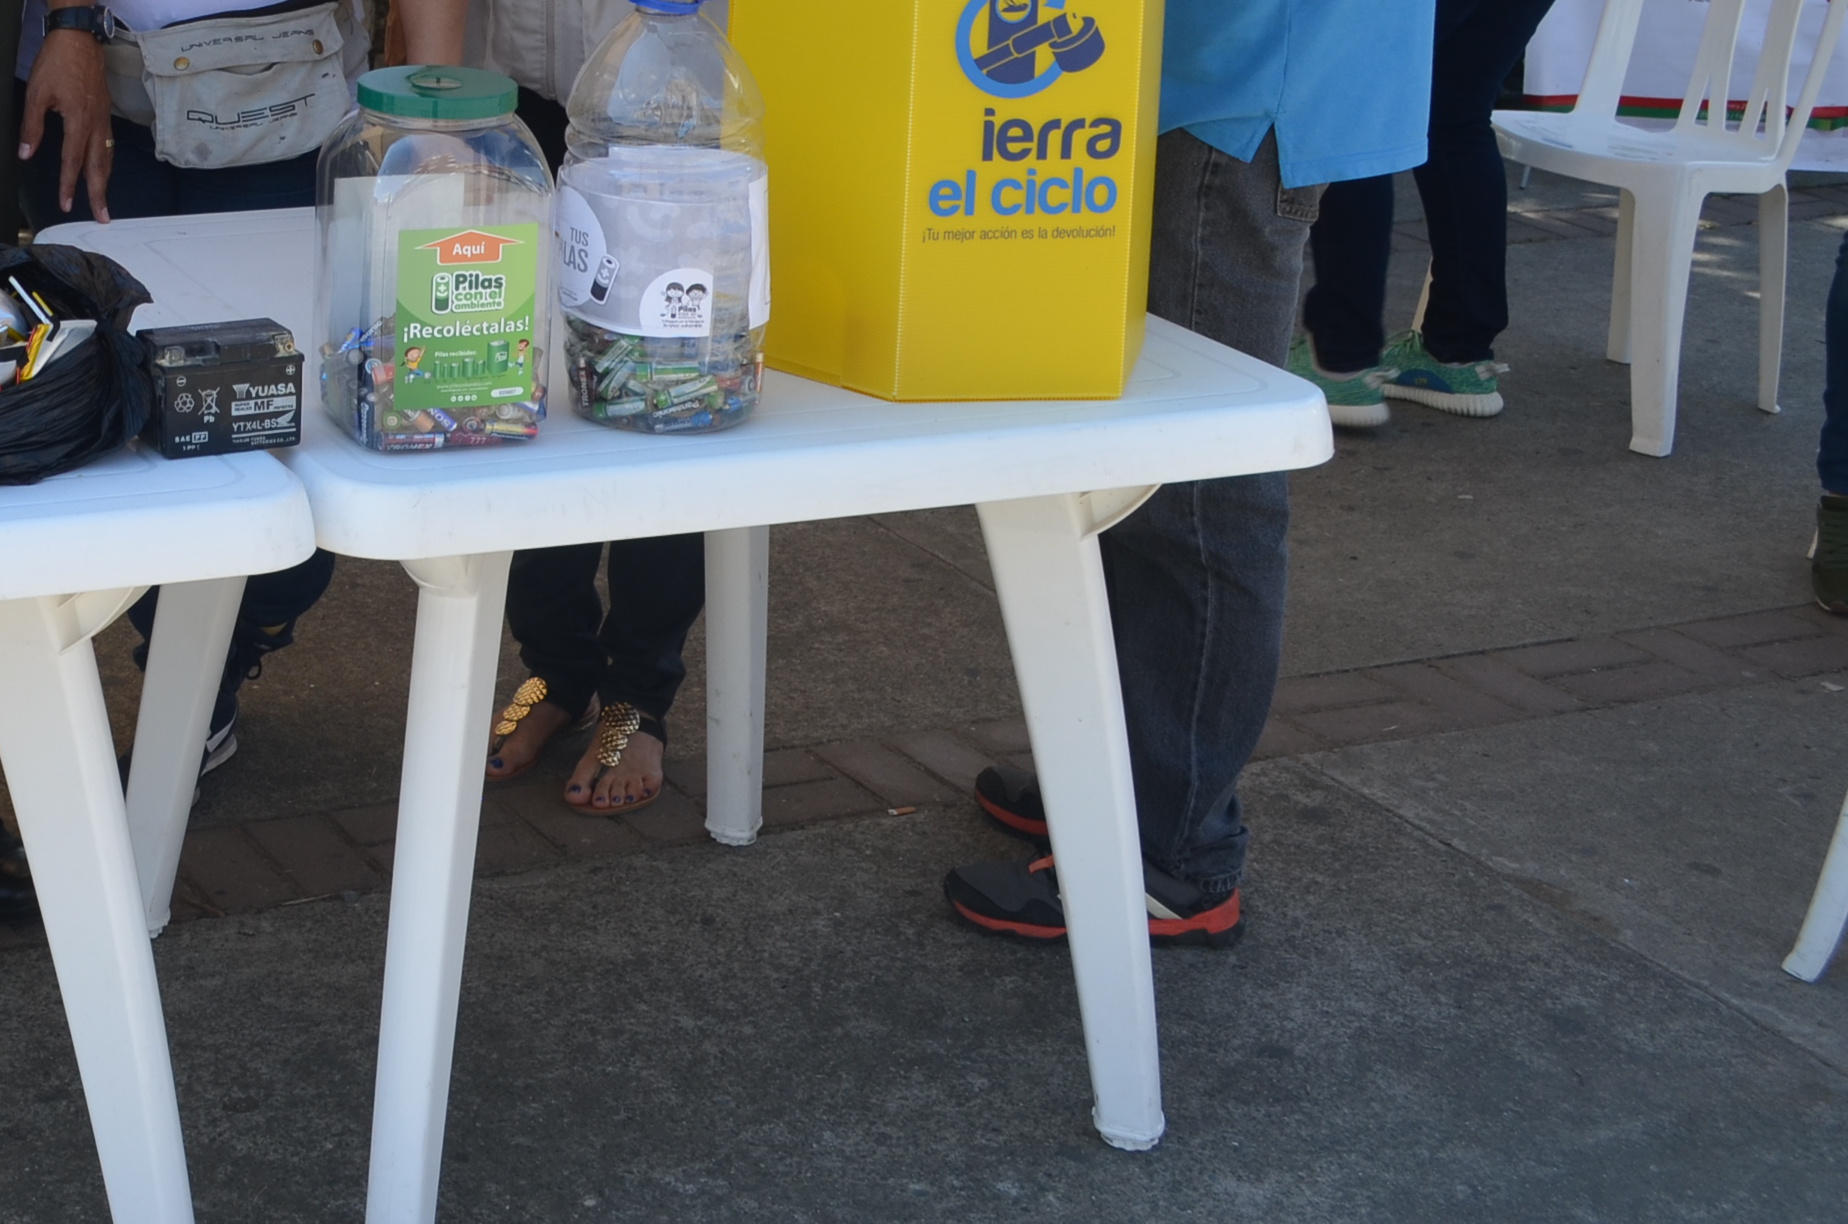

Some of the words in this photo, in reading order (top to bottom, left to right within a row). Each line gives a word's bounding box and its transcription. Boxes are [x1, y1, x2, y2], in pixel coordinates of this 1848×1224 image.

[181, 35, 265, 53] UNIVERSAL
[272, 29, 314, 40] JEANS
[186, 93, 316, 126] QUEST
[981, 108, 1122, 162] ierra
[928, 169, 976, 218] el
[990, 167, 1118, 216] ciclo
[569, 226, 590, 247] TUS
[922, 228, 940, 243] ¡Tu
[943, 228, 976, 243] mejor
[979, 227, 1018, 240] acción
[1021, 229, 1035, 240] es
[1038, 226, 1048, 239] la
[1051, 225, 1117, 239] devolución!
[452, 242, 486, 258] Aquí
[454, 273, 504, 292] Pilas
[454, 290, 484, 302] con
[487, 288, 502, 300] el
[453, 300, 503, 311] ambiente
[403, 315, 530, 344] ¡Recoléctalas!
[249, 382, 296, 398] YUASA
[581, 370, 590, 407] TRONEX
[253, 399, 274, 413] MF
[203, 415, 215, 424] Pb
[232, 419, 278, 432] YTX4L-BS
[427, 406, 452, 429] SON
